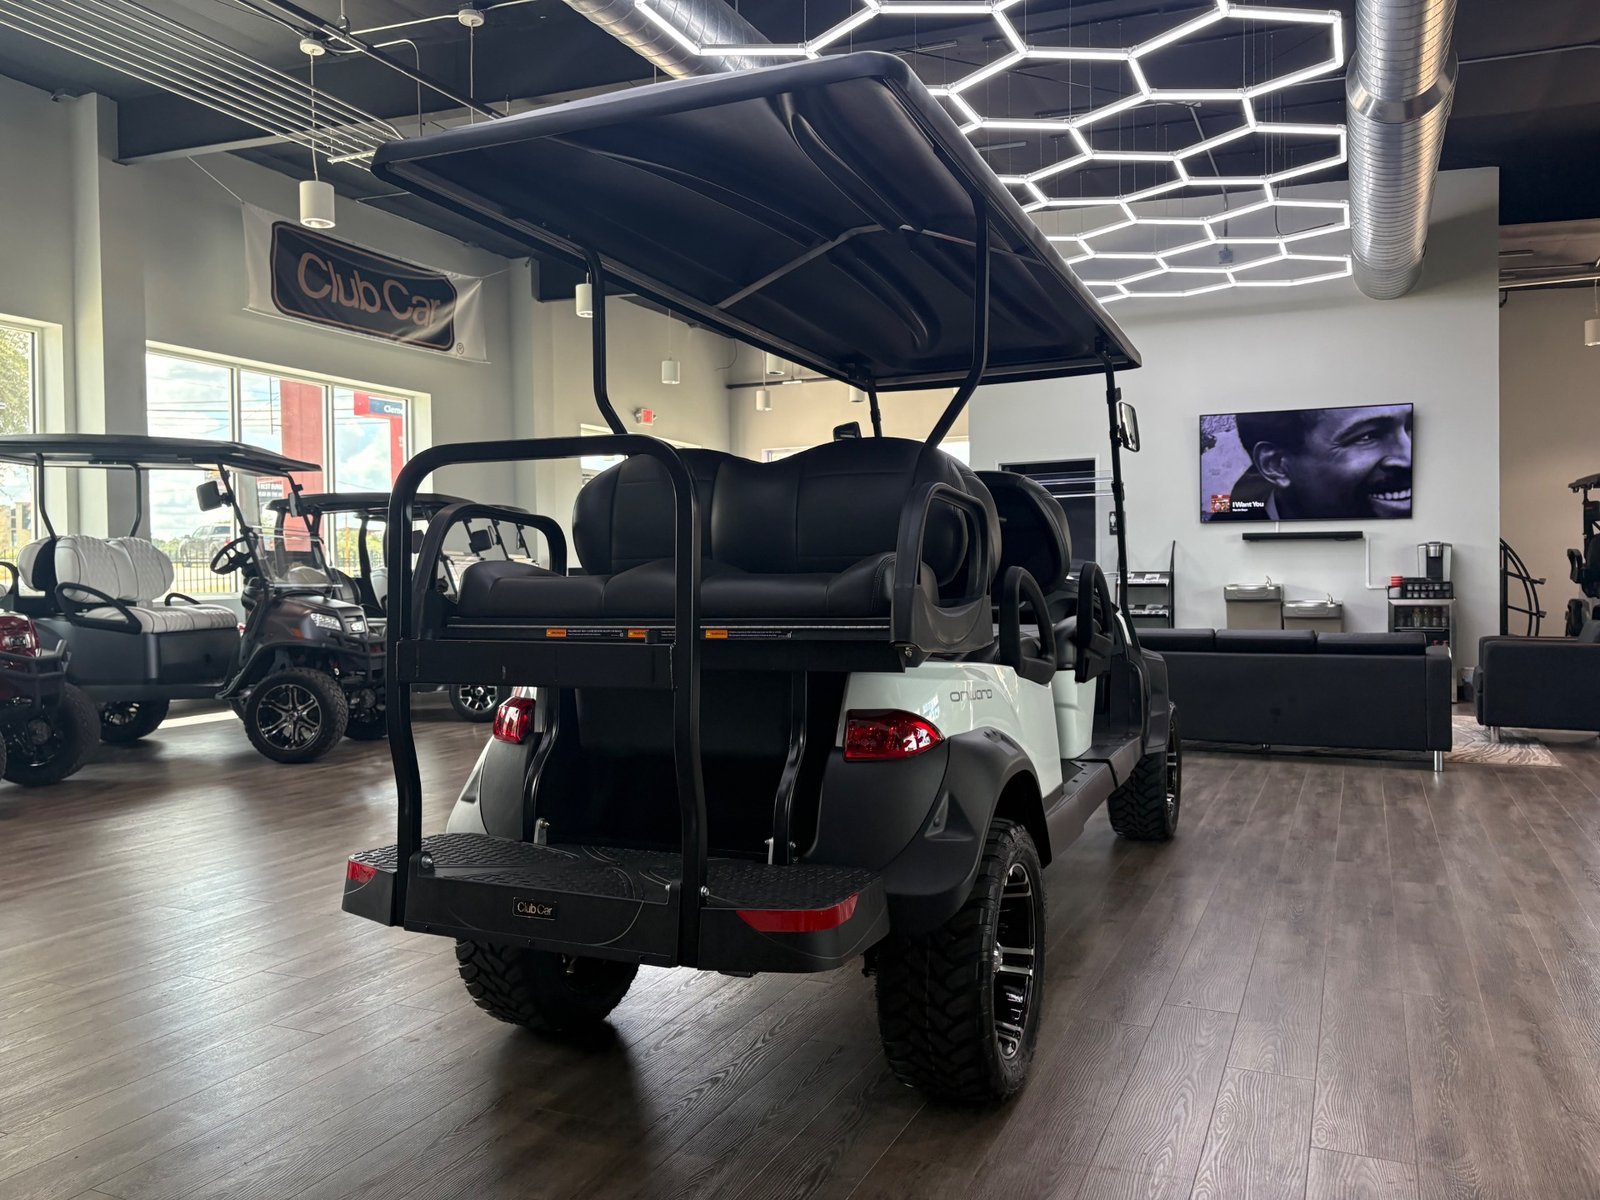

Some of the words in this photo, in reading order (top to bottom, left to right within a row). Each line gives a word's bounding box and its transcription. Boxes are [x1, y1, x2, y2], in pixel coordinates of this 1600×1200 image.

[297, 252, 382, 314] Club
[383, 279, 441, 327] Car
[517, 901, 537, 914] Club
[537, 904, 553, 916] Car
